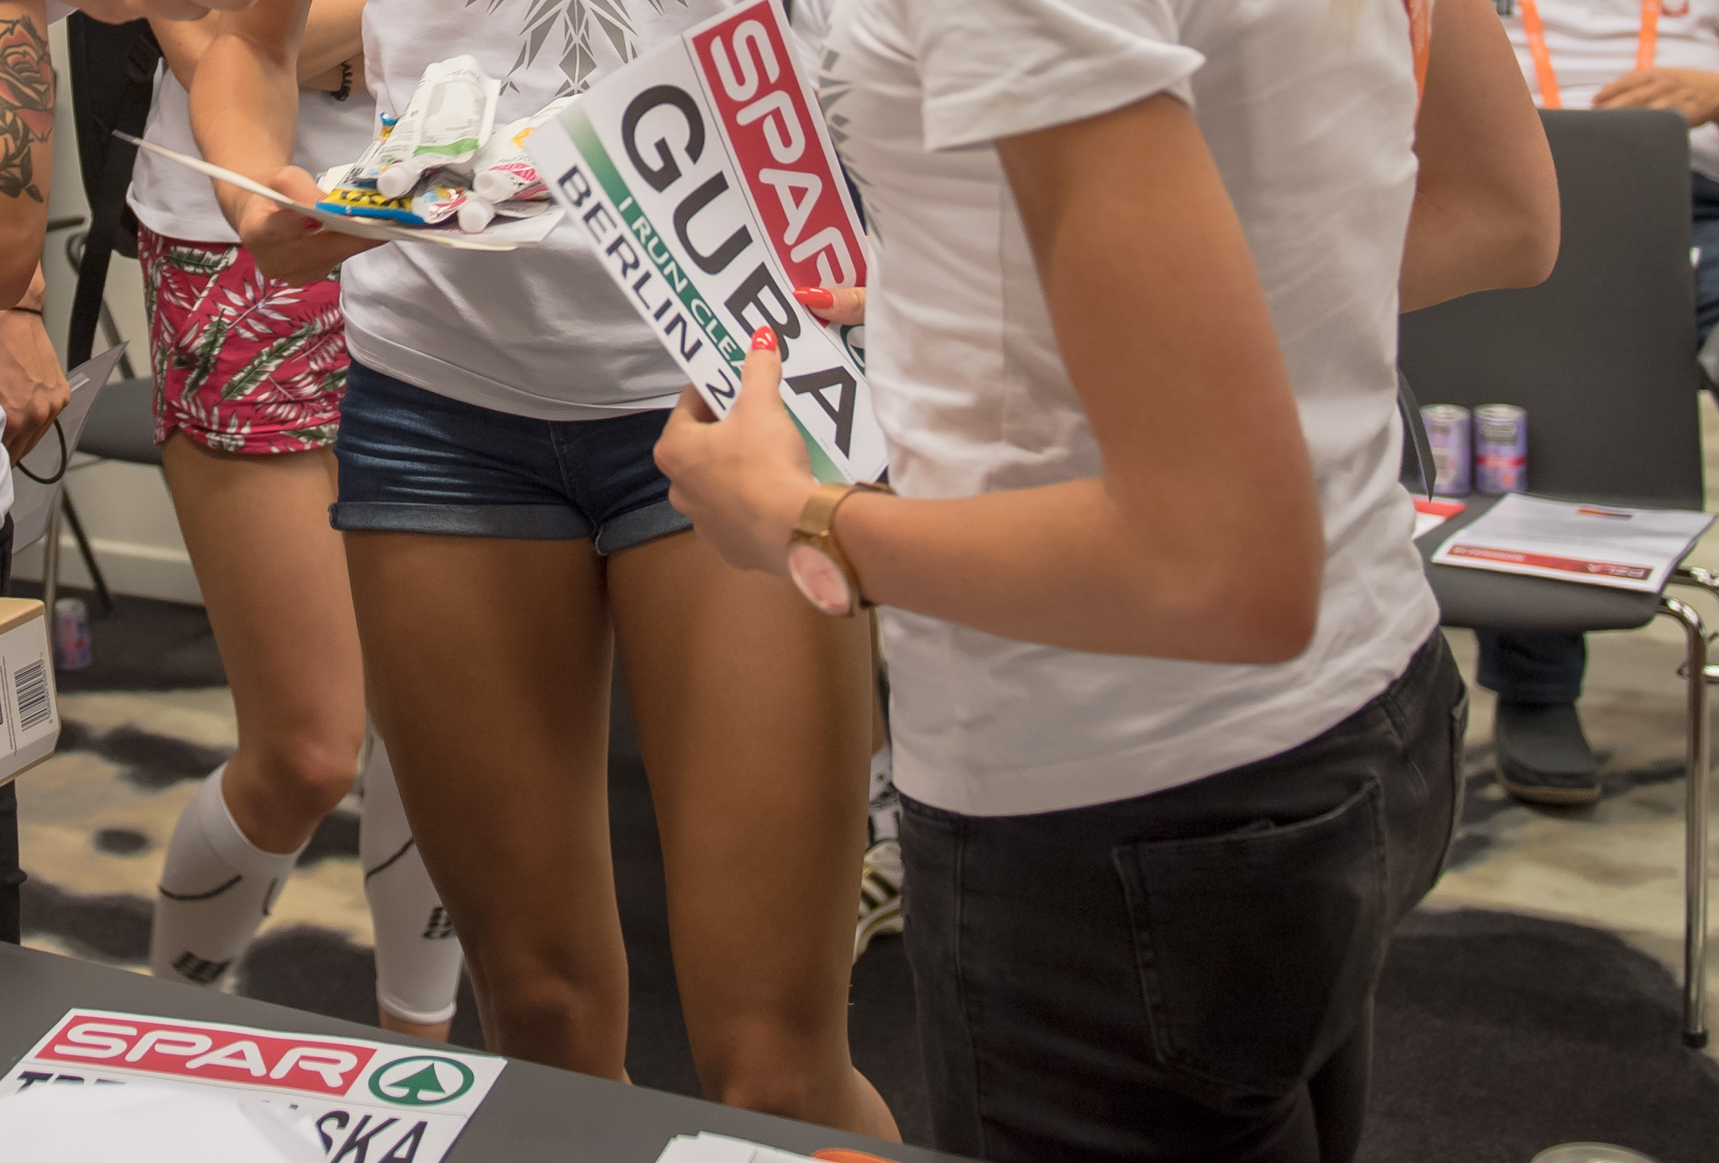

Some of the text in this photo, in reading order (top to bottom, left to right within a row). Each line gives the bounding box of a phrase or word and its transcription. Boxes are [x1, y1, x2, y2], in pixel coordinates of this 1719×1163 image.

[619, 196, 631, 211] I
[632, 215, 688, 291] RUN
[710, 19, 857, 291] SPAR
[557, 165, 704, 363] BERLIN
[621, 84, 858, 460] GUBA
[54, 1022, 359, 1088] SPAR
